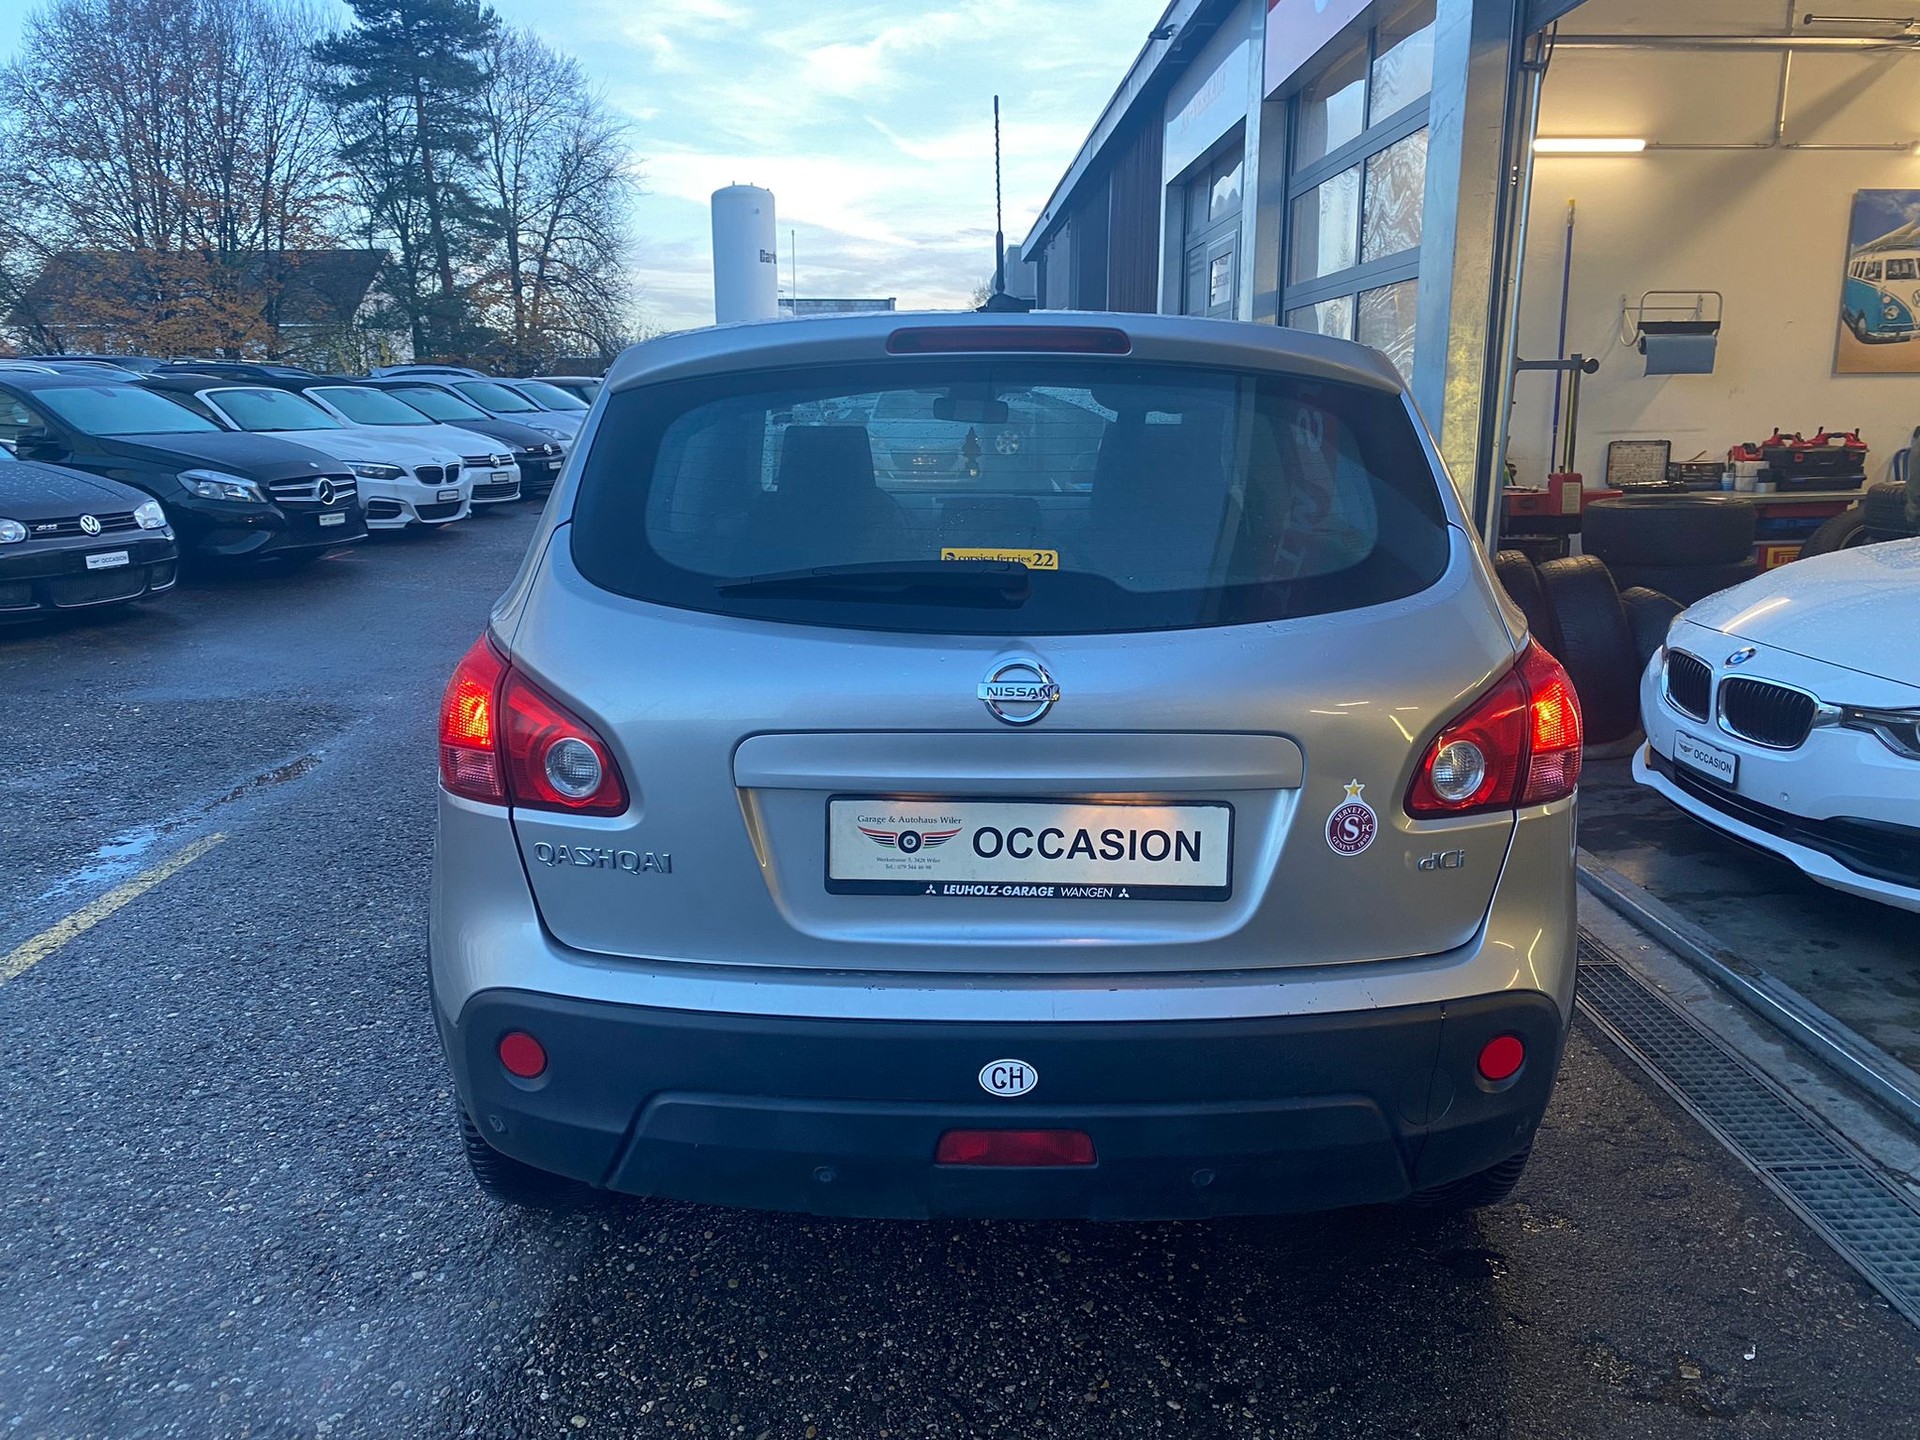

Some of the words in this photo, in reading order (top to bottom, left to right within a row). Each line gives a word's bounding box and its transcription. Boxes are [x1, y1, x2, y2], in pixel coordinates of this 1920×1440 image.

[1032, 552, 1055, 567] 22
[986, 686, 1051, 698] NISSAN
[1693, 749, 1733, 774] OCCASION
[857, 814, 886, 825] Garage
[888, 816, 896, 824] &
[898, 815, 938, 824] Autohaus
[939, 815, 962, 825] Wiler
[1343, 816, 1360, 841] S
[972, 826, 1202, 862] OCCASION
[533, 841, 673, 876] QASHQAI
[1417, 849, 1466, 871] dCi
[943, 884, 1055, 897] LEUHOLZ-GARAGE
[1060, 886, 1114, 899] WANGEN
[991, 1066, 1024, 1090] CH
